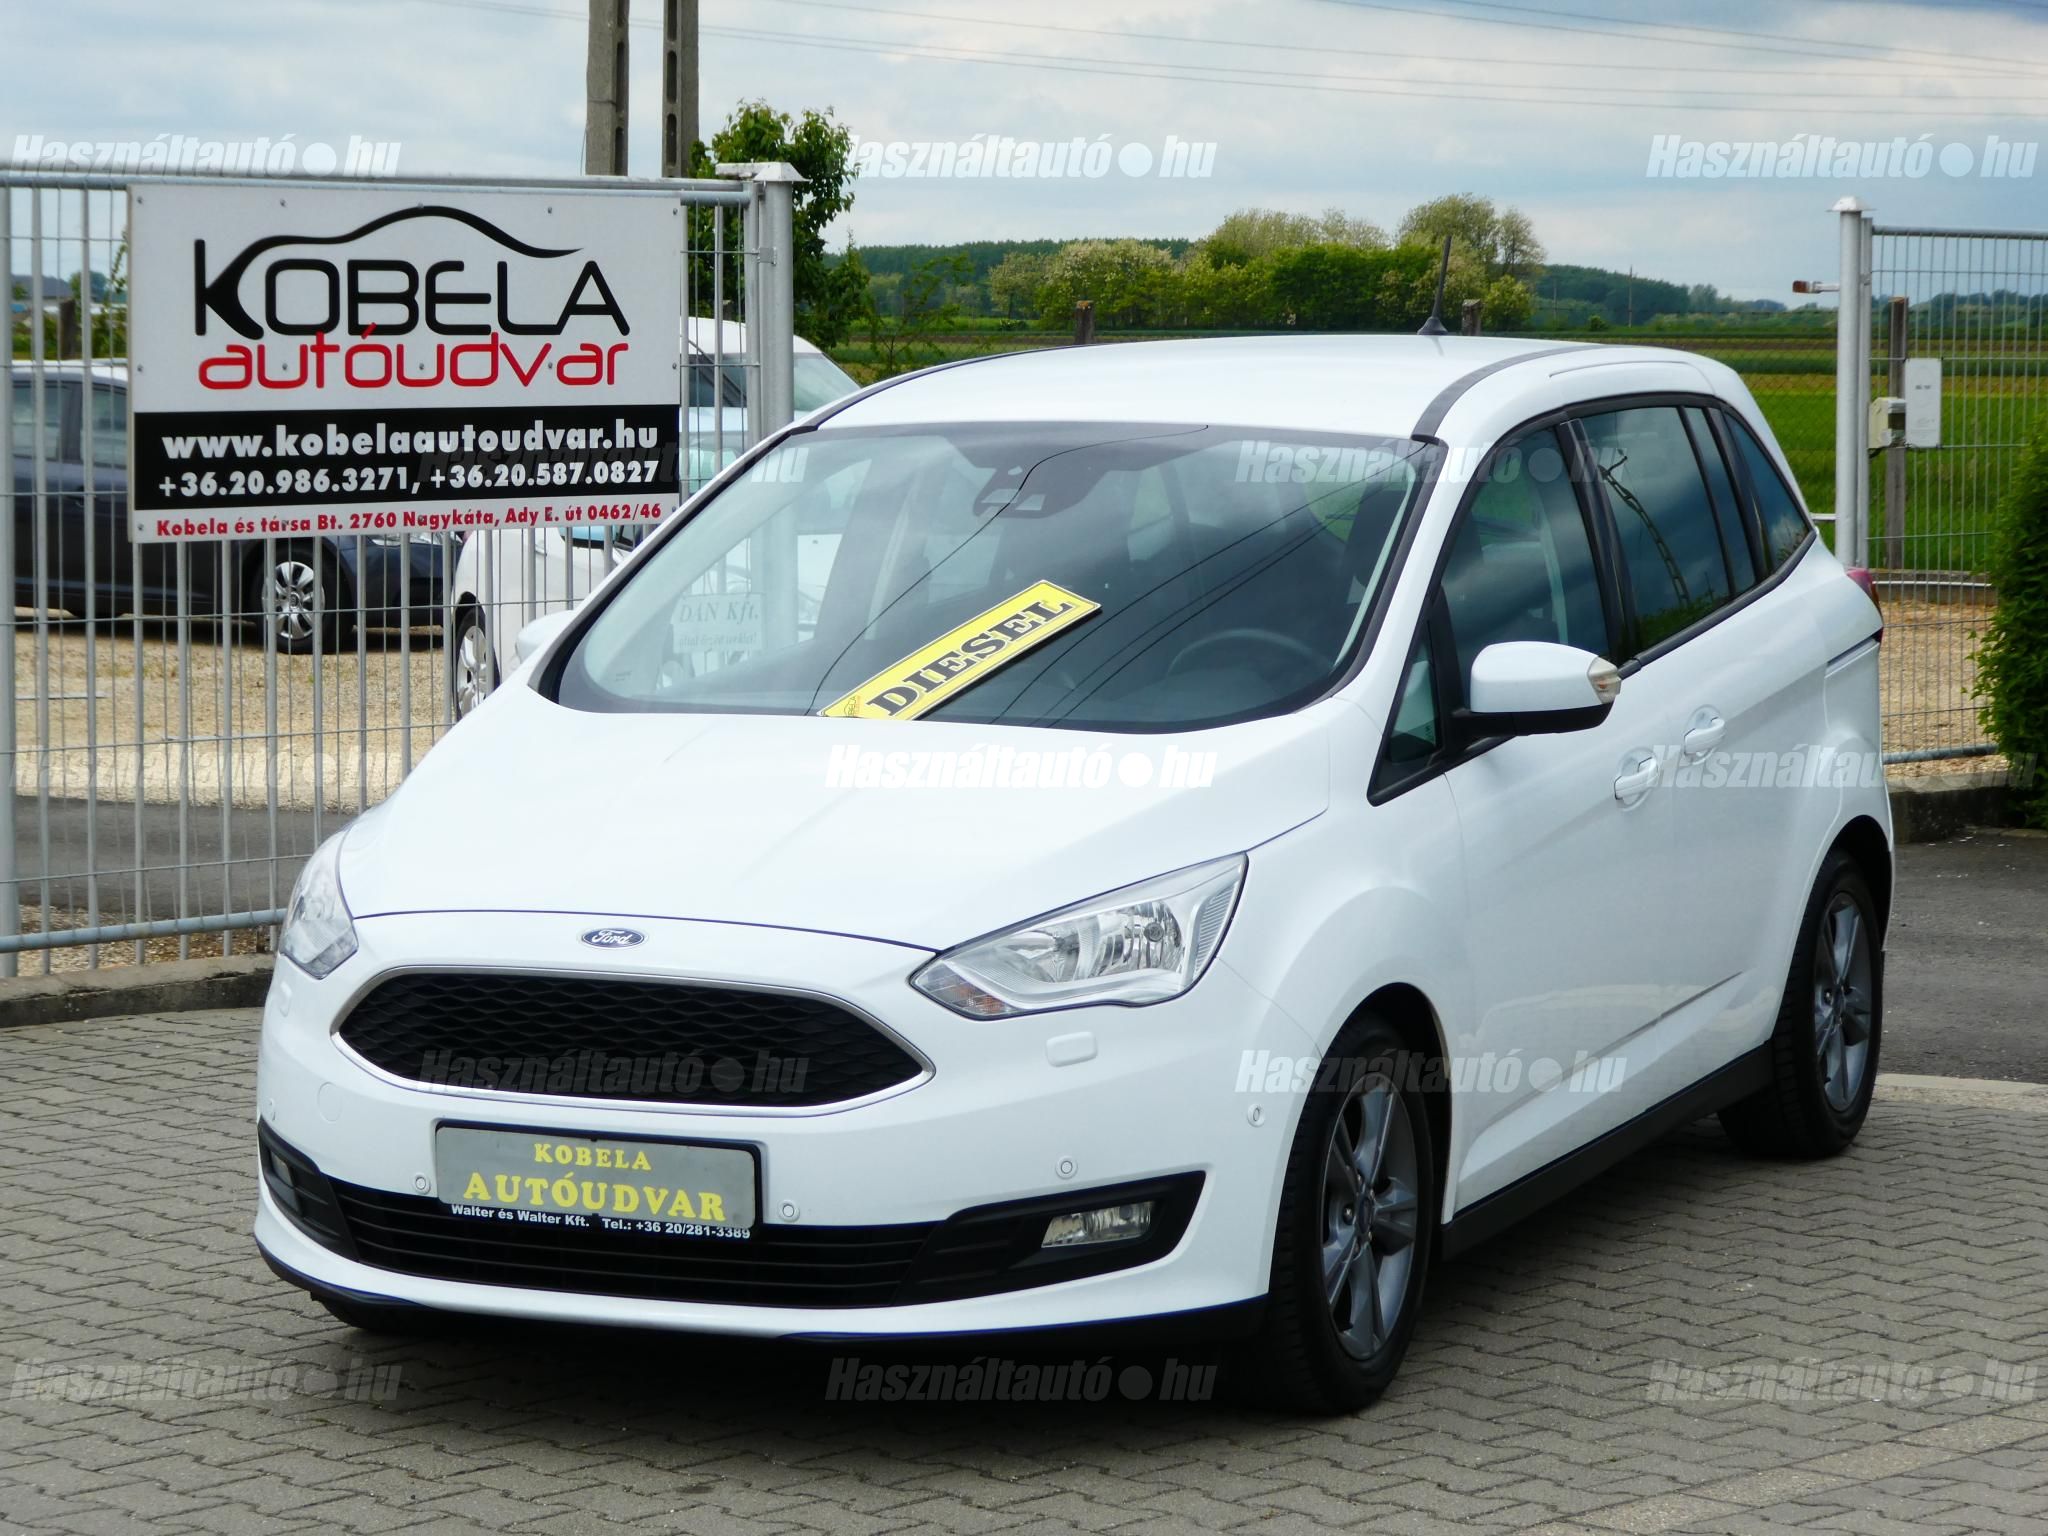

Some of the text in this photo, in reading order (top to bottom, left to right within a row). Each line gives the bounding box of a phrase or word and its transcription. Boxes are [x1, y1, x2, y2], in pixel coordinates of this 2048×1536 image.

[194, 236, 630, 340] KOBELA
[198, 323, 629, 390] autóudvar
[161, 418, 658, 459] www.kobelaautoudvar.hu
[158, 460, 659, 497] +36.20.986.3271, +36.20.587.0827
[157, 503, 662, 536] Kobela és társa Bt. 2760 Nagykáta, Ady E. út 0462/46
[866, 599, 1074, 716] DIESEL
[591, 928, 633, 945] Ford
[534, 1143, 652, 1171] KOBELA
[463, 1171, 727, 1222] AUTÓUDVAR
[451, 1204, 495, 1218] Walter
[498, 1208, 514, 1220] és
[517, 1210, 561, 1225] Walter
[565, 1214, 590, 1227] Kft.
[602, 1217, 632, 1231] Tel.:
[635, 1221, 661, 1233] +36
